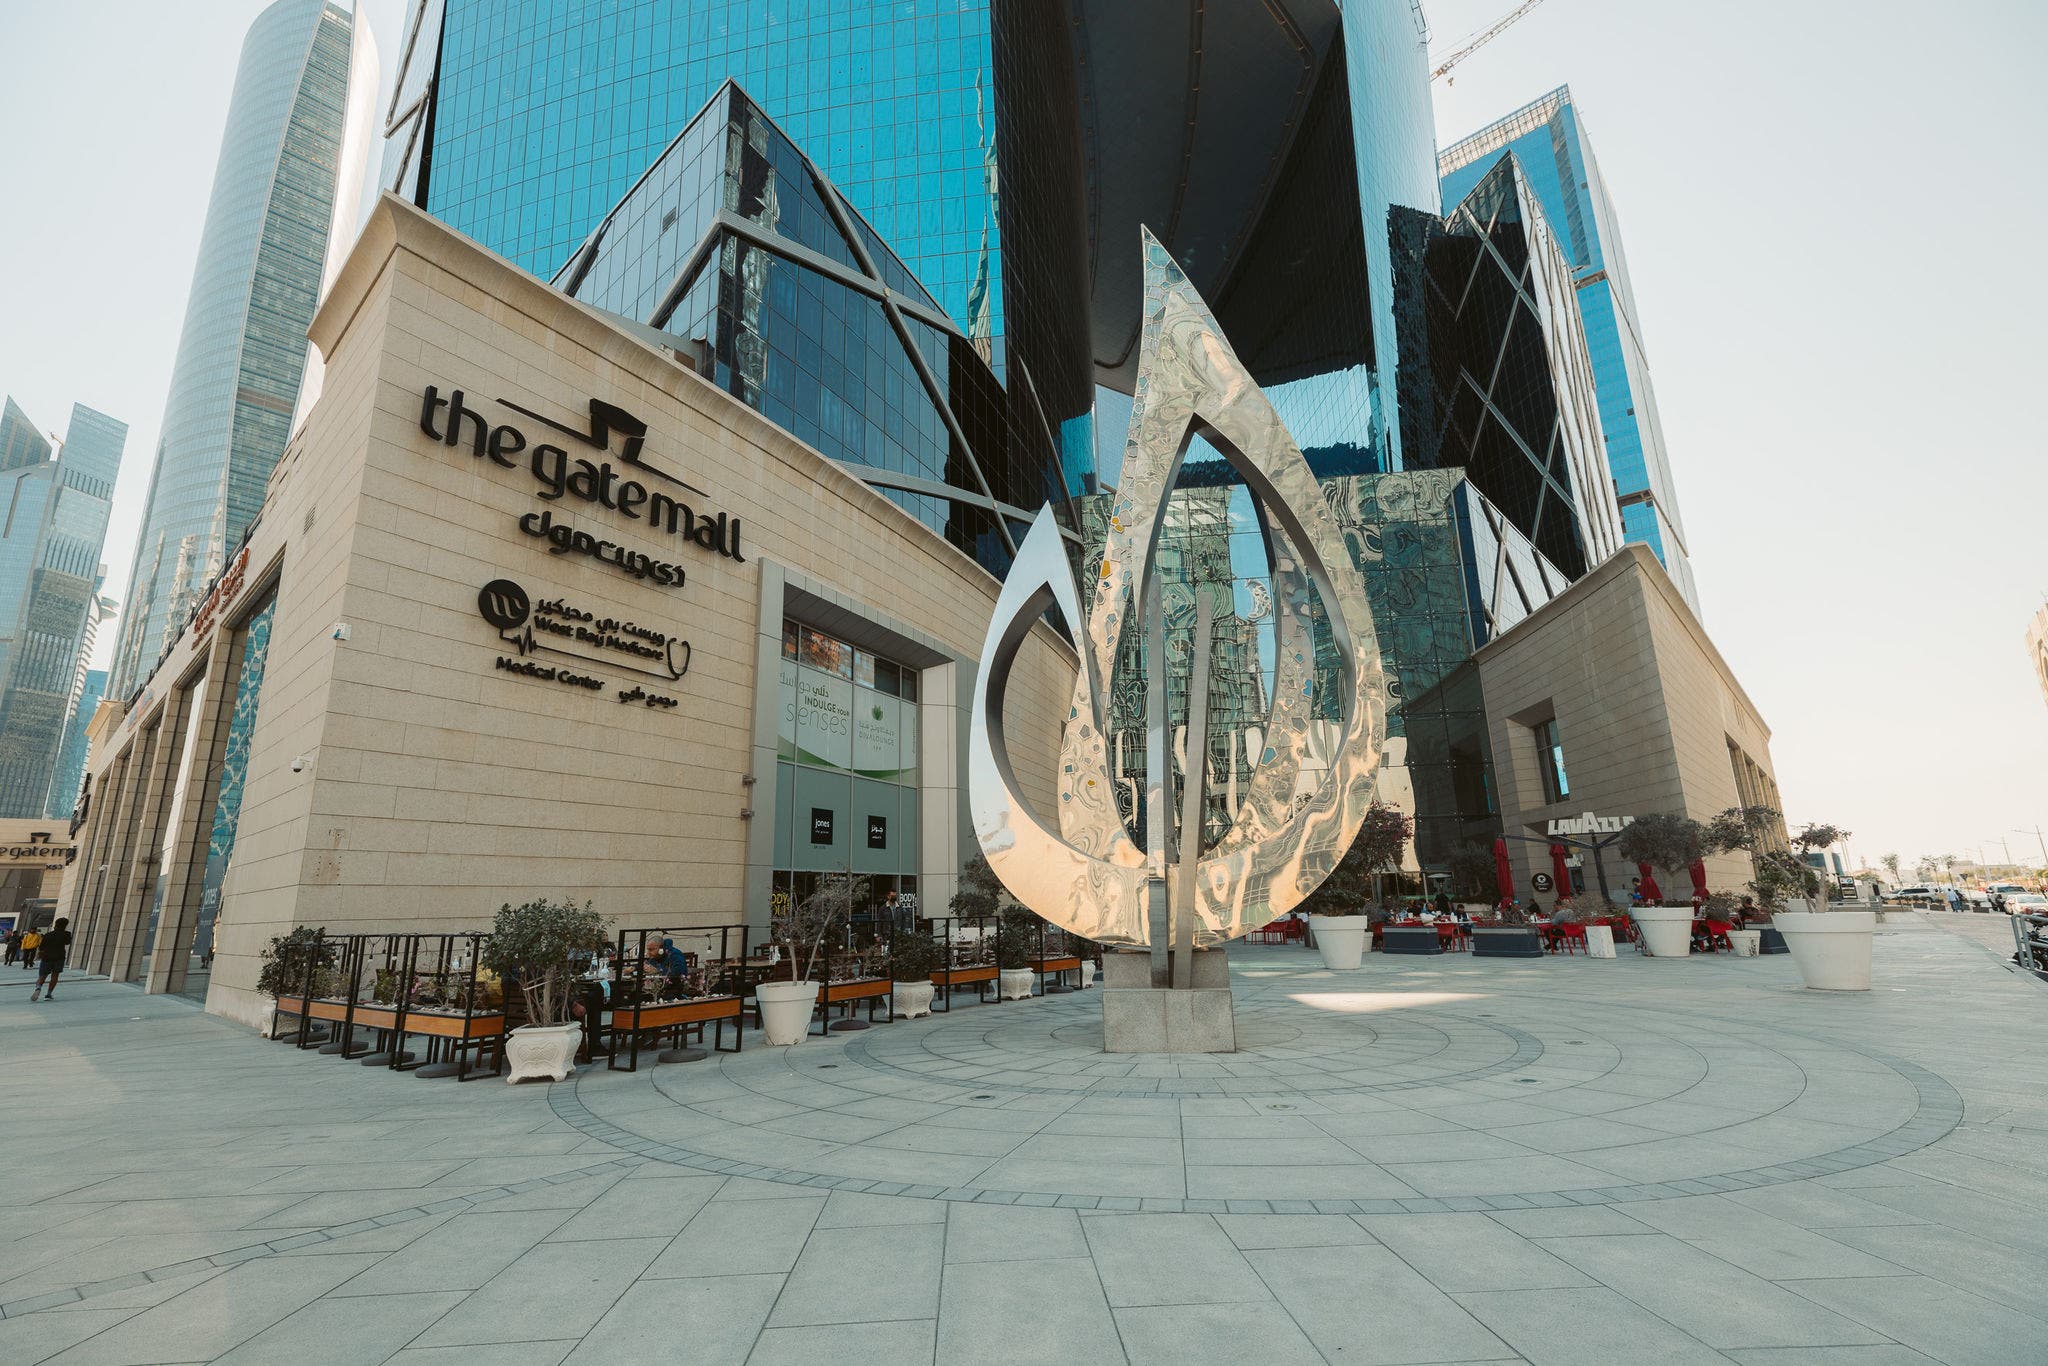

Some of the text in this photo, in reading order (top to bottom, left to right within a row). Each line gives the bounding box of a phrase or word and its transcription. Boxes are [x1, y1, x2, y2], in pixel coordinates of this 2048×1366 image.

[534, 615, 664, 660] West Bay Medicare
[495, 656, 605, 690] Medical Center
[785, 703, 847, 736] senses
[804, 695, 836, 713] INDULGE
[815, 818, 830, 828] jones
